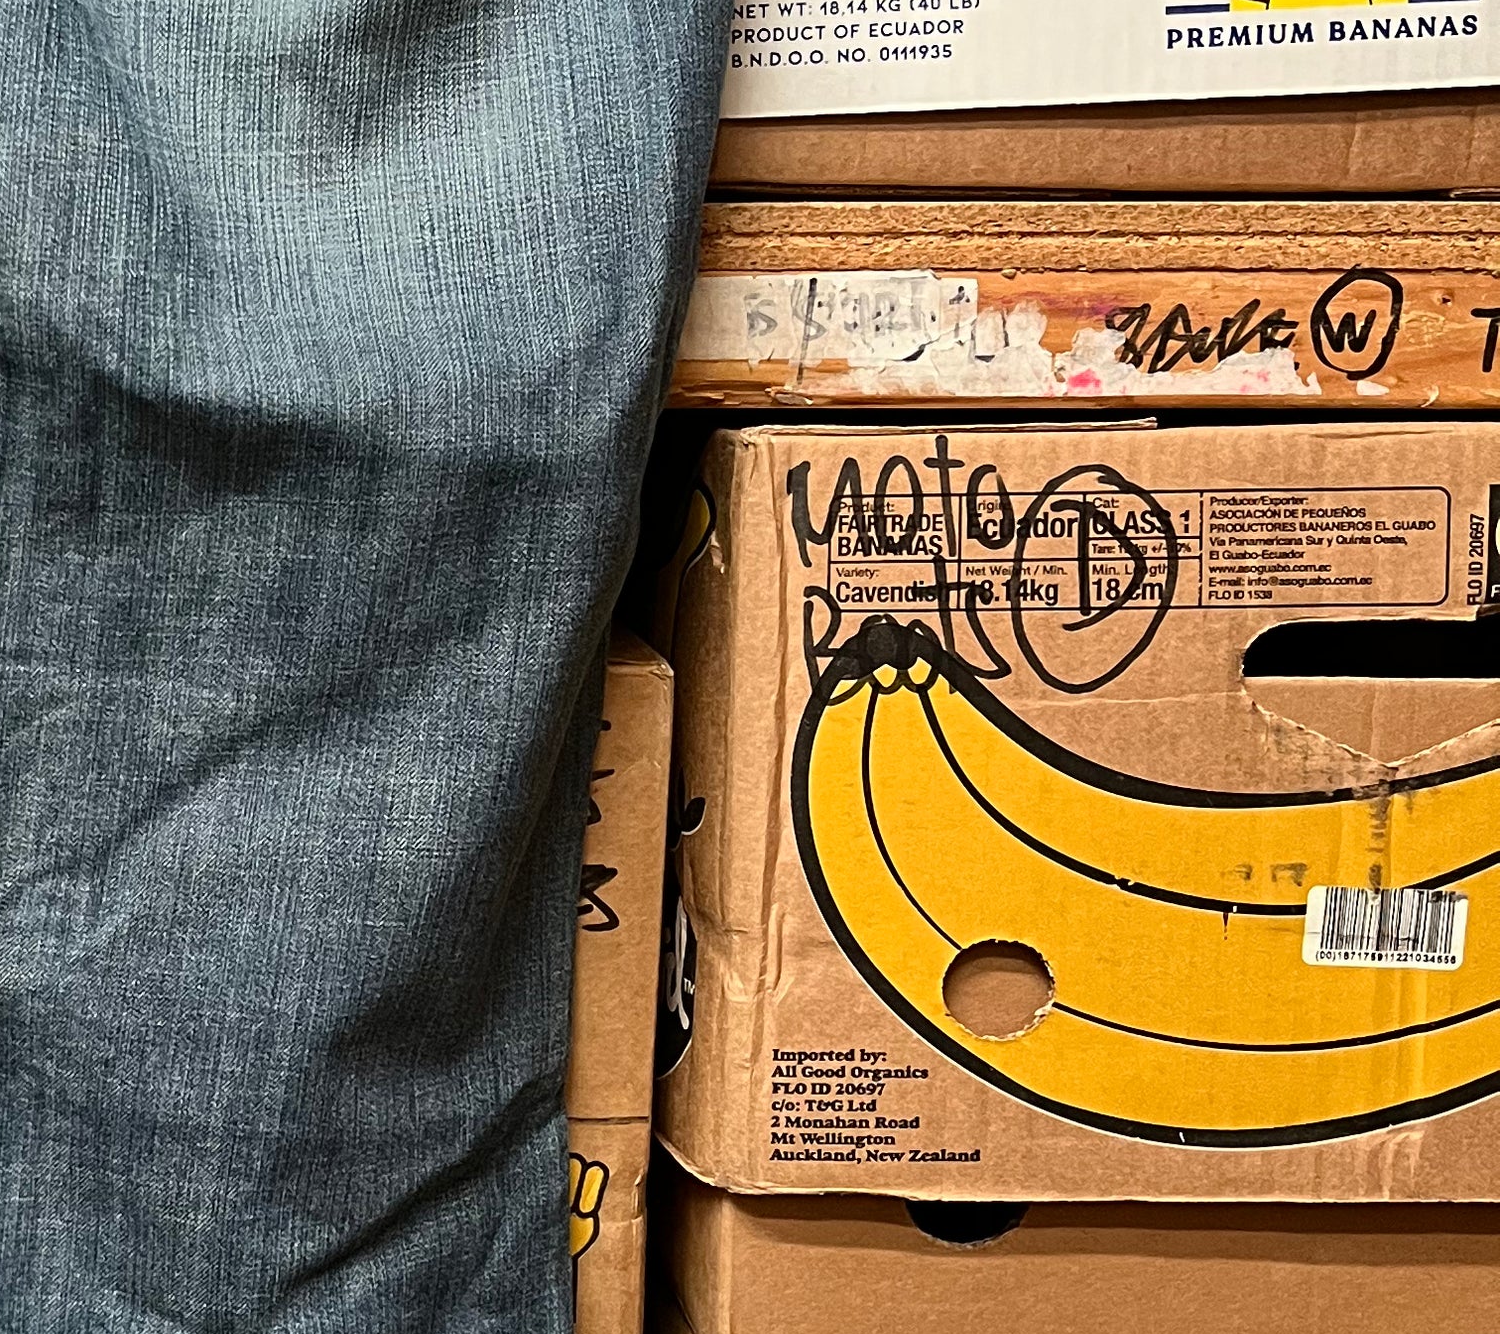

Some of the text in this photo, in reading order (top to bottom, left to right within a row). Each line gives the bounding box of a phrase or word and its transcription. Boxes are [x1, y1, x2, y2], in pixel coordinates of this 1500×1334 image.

[731, 19, 964, 44] PRODUCT OF ECUADOR
[1167, 14, 1480, 50] PREMIUM BANANAS
[1092, 497, 1120, 509] Cat:
[1284, 509, 1298, 518] DE
[1376, 521, 1390, 531] EL
[1469, 514, 1485, 558] 20697
[836, 568, 880, 579] Variety:
[966, 566, 989, 576] Net
[772, 1049, 887, 1065] Imported by:
[771, 1065, 929, 1082] All Good Organics
[771, 1082, 886, 1096] FLO ID 20697
[847, 1099, 878, 1112] Ltd
[784, 1116, 921, 1129] Monahan Road
[770, 1132, 896, 1149] Mt Wellington
[769, 1149, 981, 1164] Auckland, New Zealand
